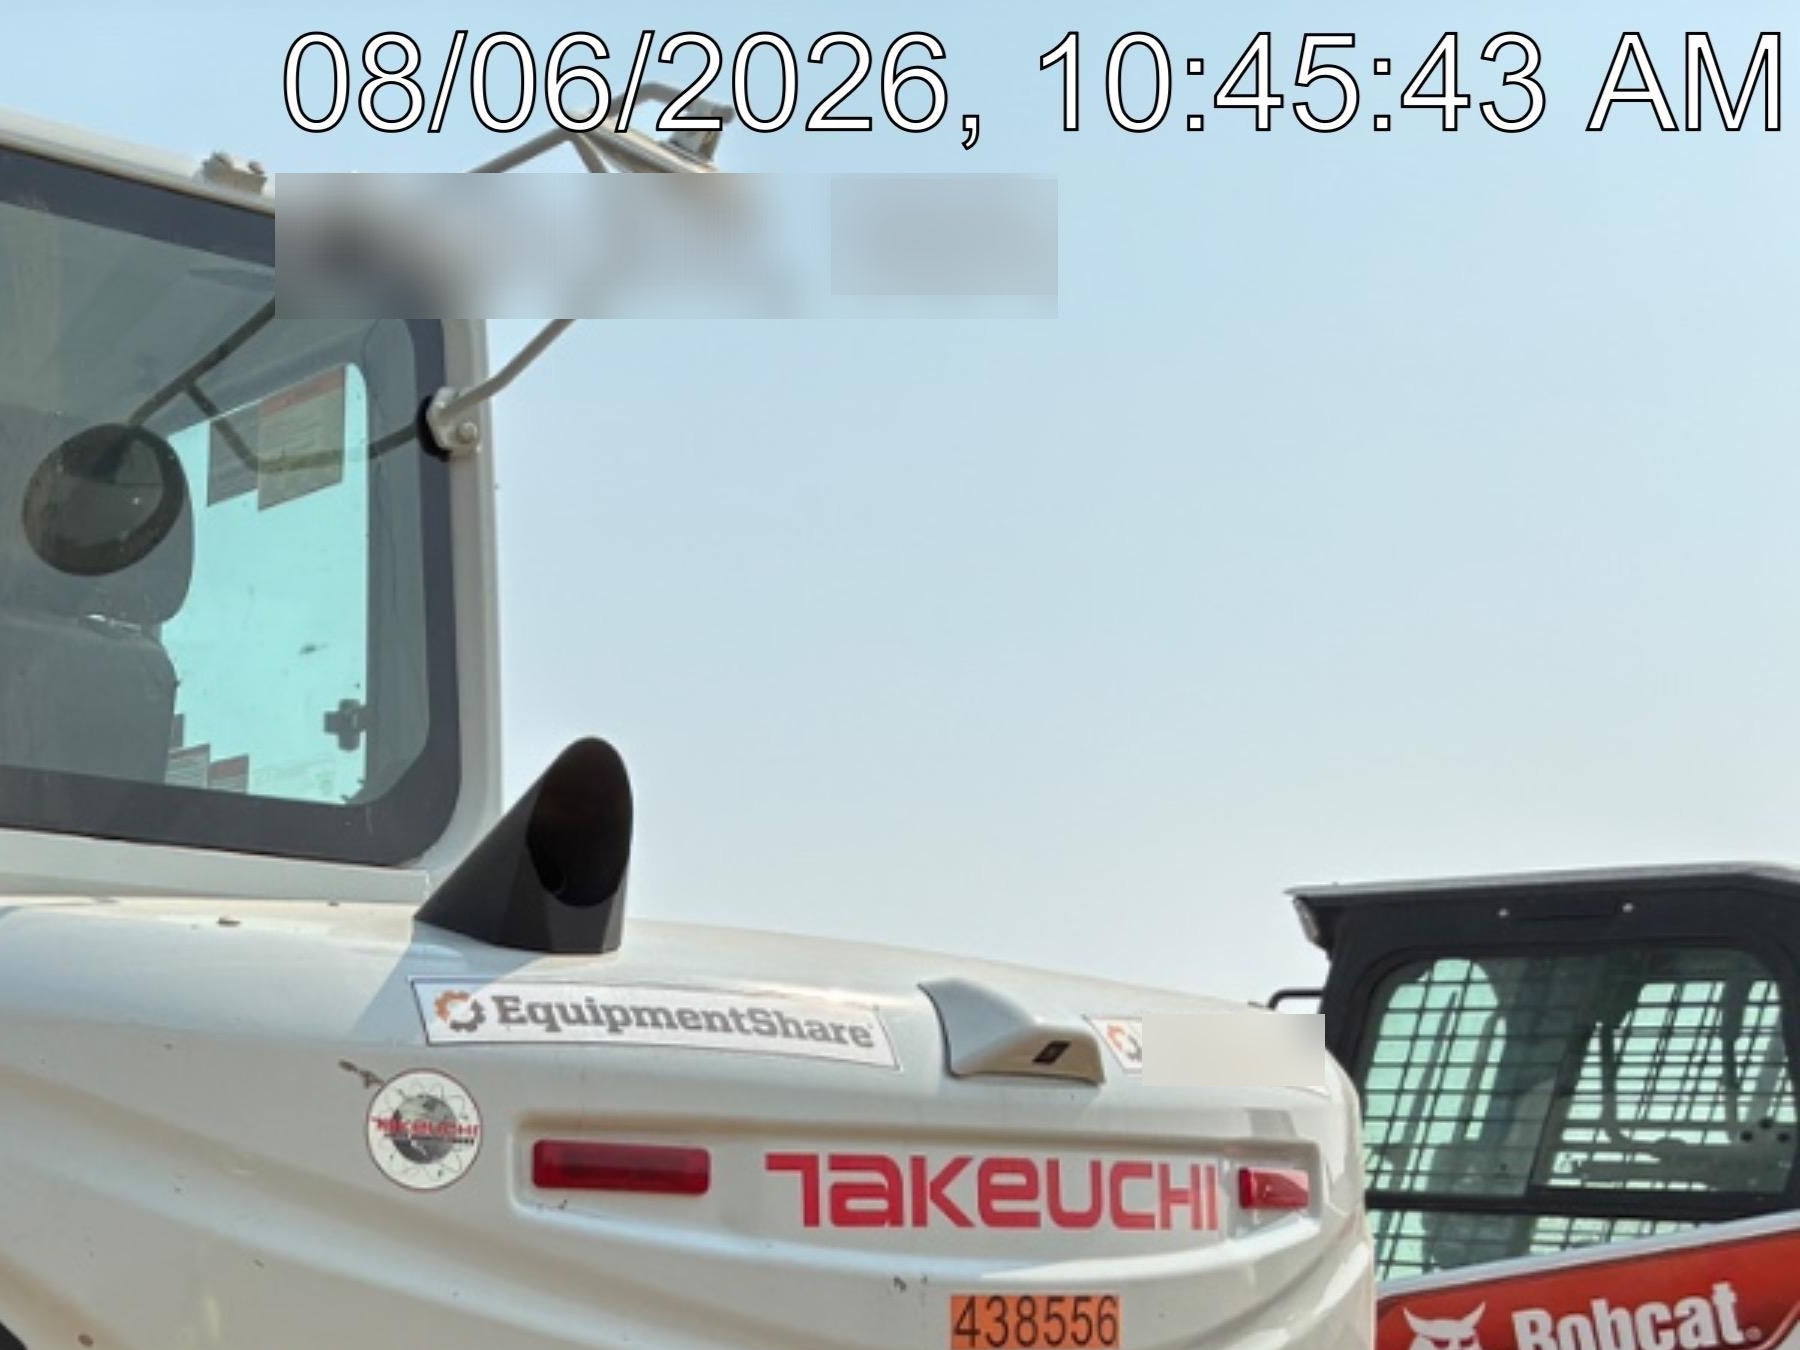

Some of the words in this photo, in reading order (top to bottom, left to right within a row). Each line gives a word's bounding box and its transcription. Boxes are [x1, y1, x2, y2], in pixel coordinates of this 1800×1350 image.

[490, 995, 874, 1048] EquipmentShare
[764, 1153, 1219, 1231] TAKEUCHI
[952, 1295, 1119, 1349] 438556
